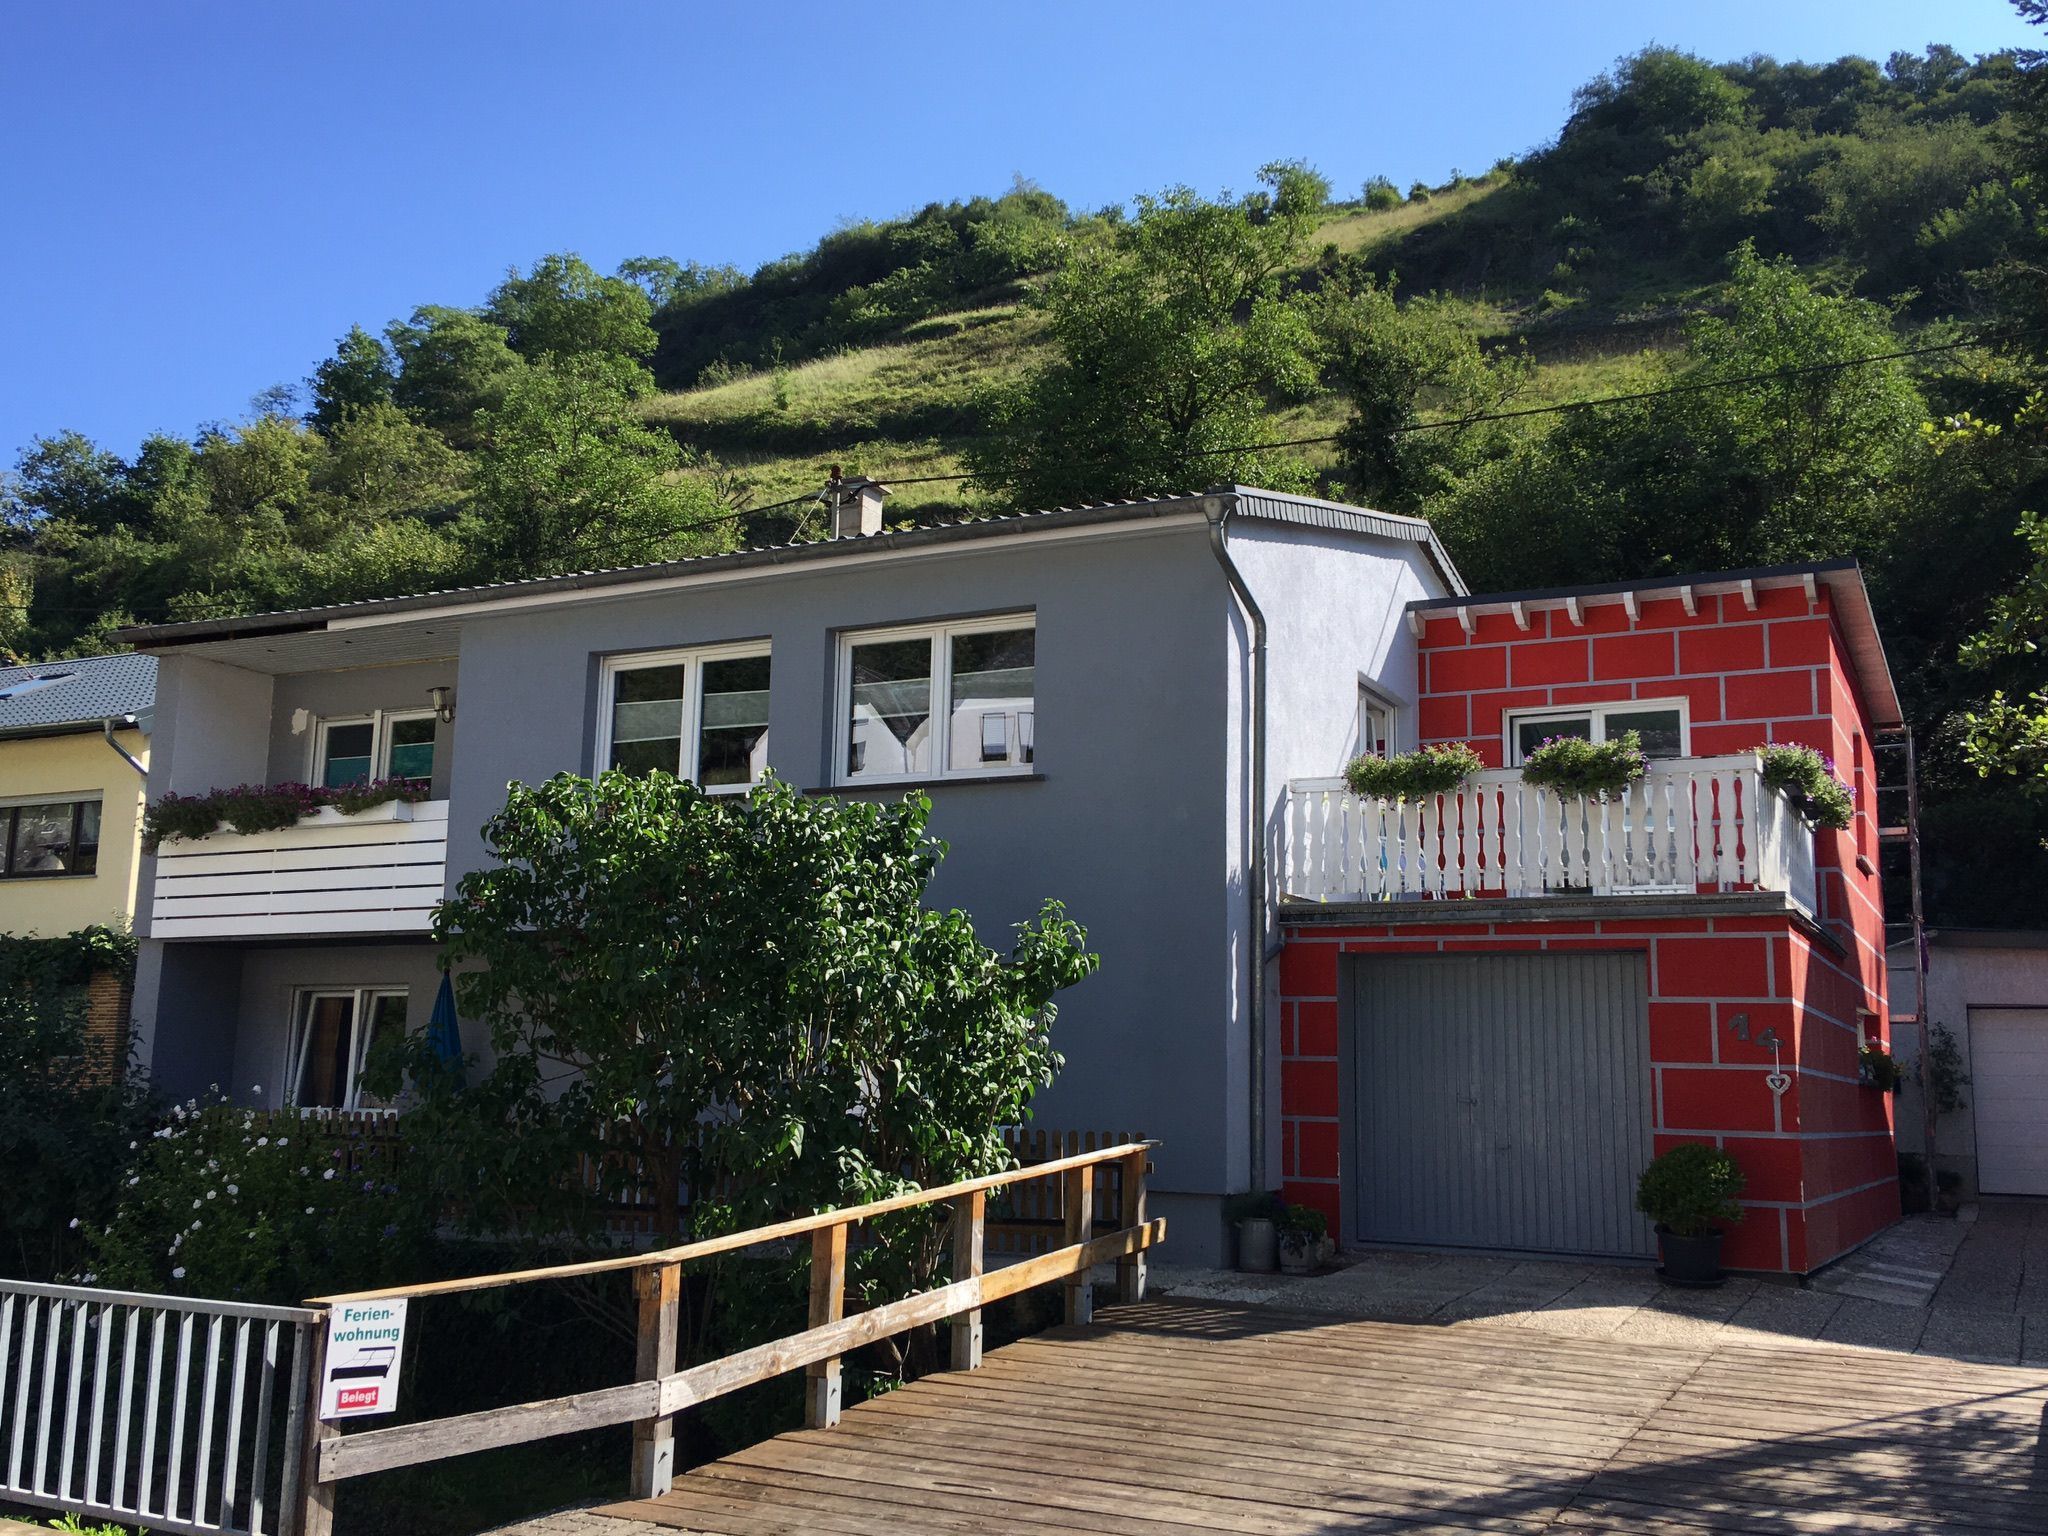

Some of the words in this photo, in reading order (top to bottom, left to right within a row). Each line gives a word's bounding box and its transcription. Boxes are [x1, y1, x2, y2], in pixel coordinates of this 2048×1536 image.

[1728, 1013, 1784, 1054] 14
[344, 1307, 395, 1322] Ferien-
[334, 1327, 400, 1342] wohnung
[341, 1390, 377, 1404] Belegt
